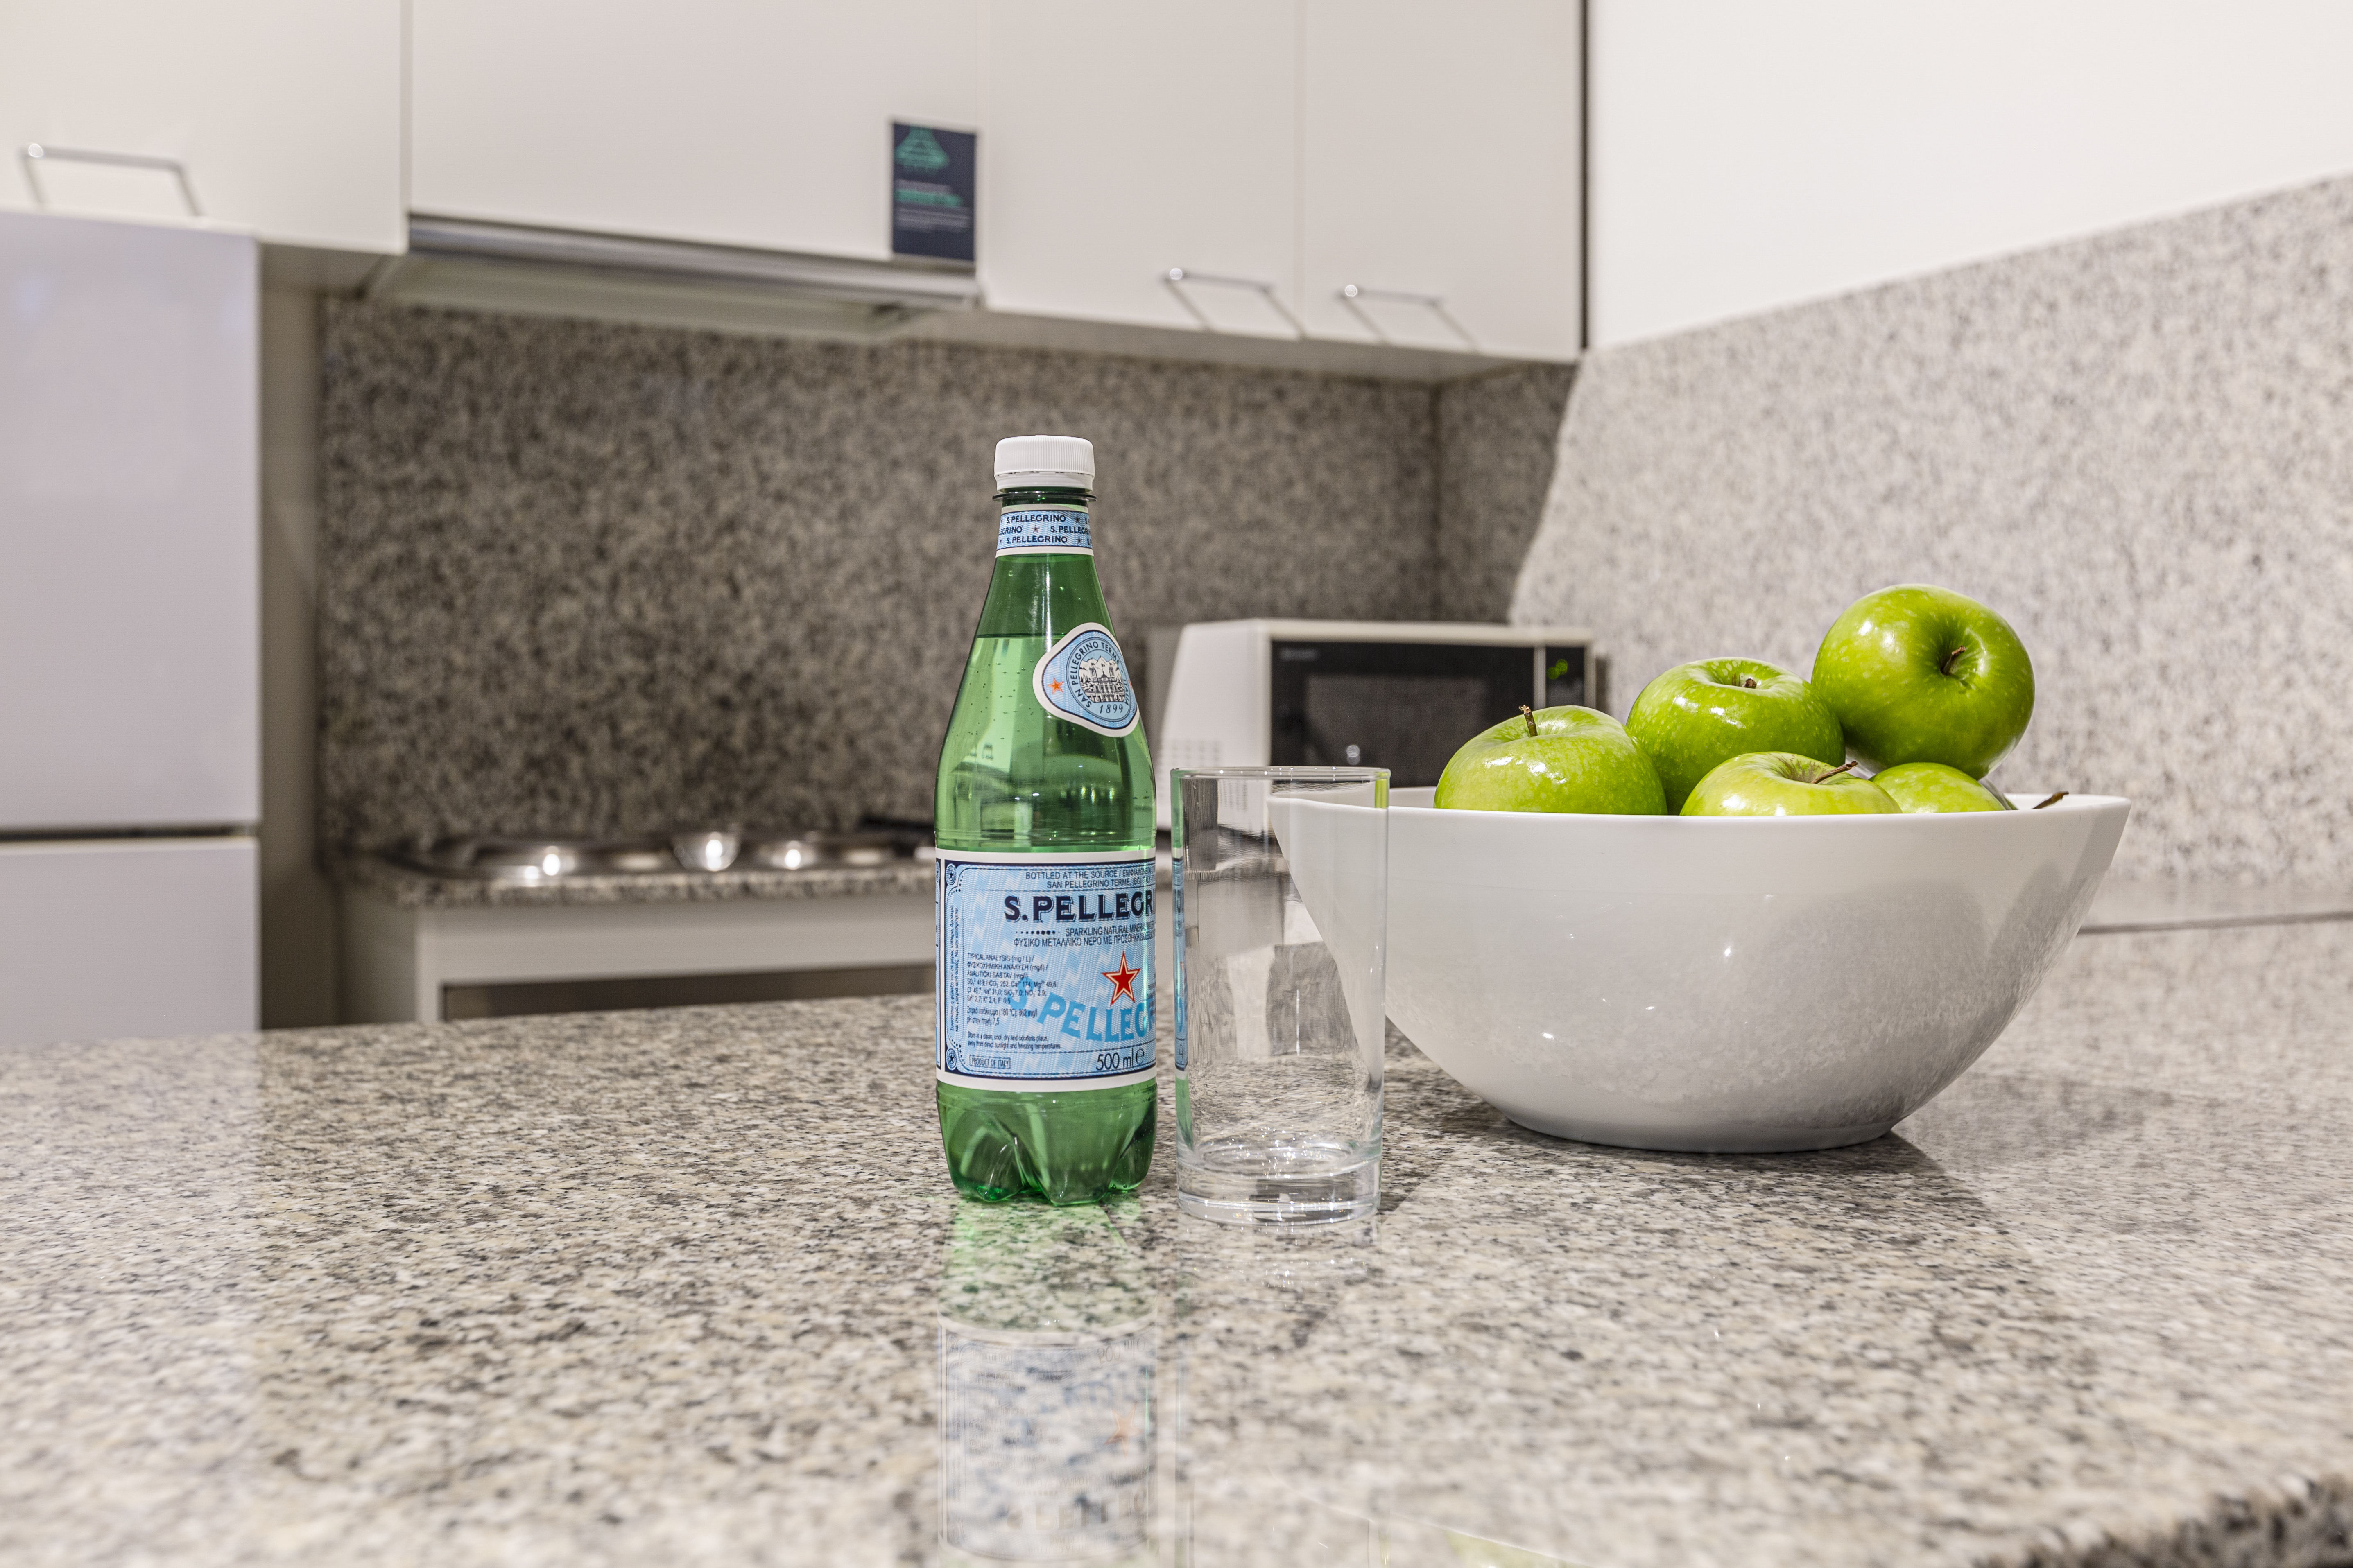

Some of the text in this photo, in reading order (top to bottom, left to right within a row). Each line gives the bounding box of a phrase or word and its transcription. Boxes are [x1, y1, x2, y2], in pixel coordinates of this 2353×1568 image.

[1101, 642, 1120, 664] TERME
[1070, 641, 1098, 685] PELLEGRINO
[1075, 689, 1092, 708] SAN
[1100, 704, 1123, 714] 1899
[1025, 872, 1060, 880] BOTTLED
[1091, 870, 1118, 879] SOURCE
[1065, 880, 1109, 889] PELLEGRINO
[1111, 878, 1130, 887] TERME
[1065, 926, 1103, 937] SPARKLING
[1104, 924, 1129, 935] NATURAL
[972, 1057, 989, 1066] PRODUCT
[1096, 1052, 1120, 1071] 500
[1123, 1048, 1134, 1067] ml
